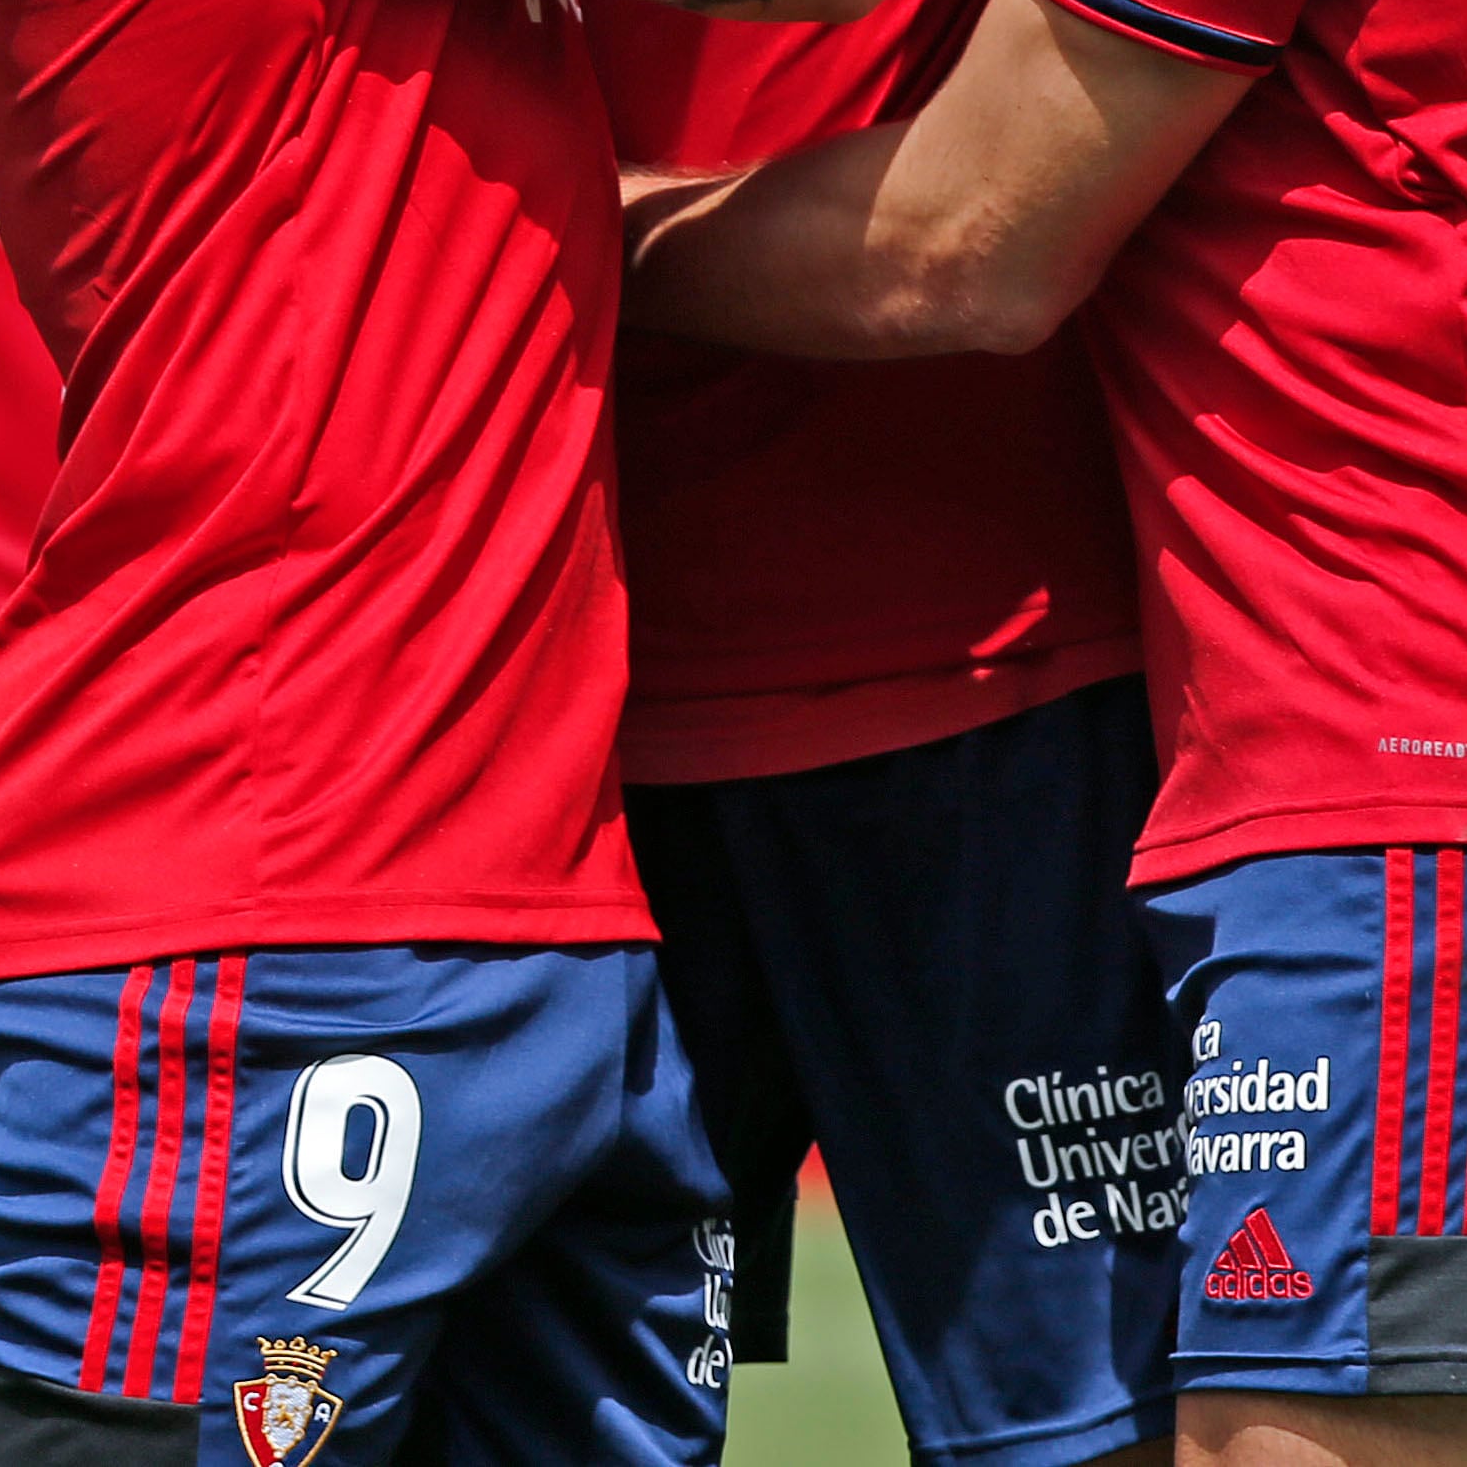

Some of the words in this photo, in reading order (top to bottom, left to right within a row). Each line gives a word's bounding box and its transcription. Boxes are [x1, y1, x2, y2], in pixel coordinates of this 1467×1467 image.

[1004, 1065, 1165, 1131] Clínica
[280, 1052, 423, 1311] 9
[1032, 1191, 1101, 1248] de
[1205, 1266, 1316, 1301] adidas
[686, 1334, 726, 1389] de
